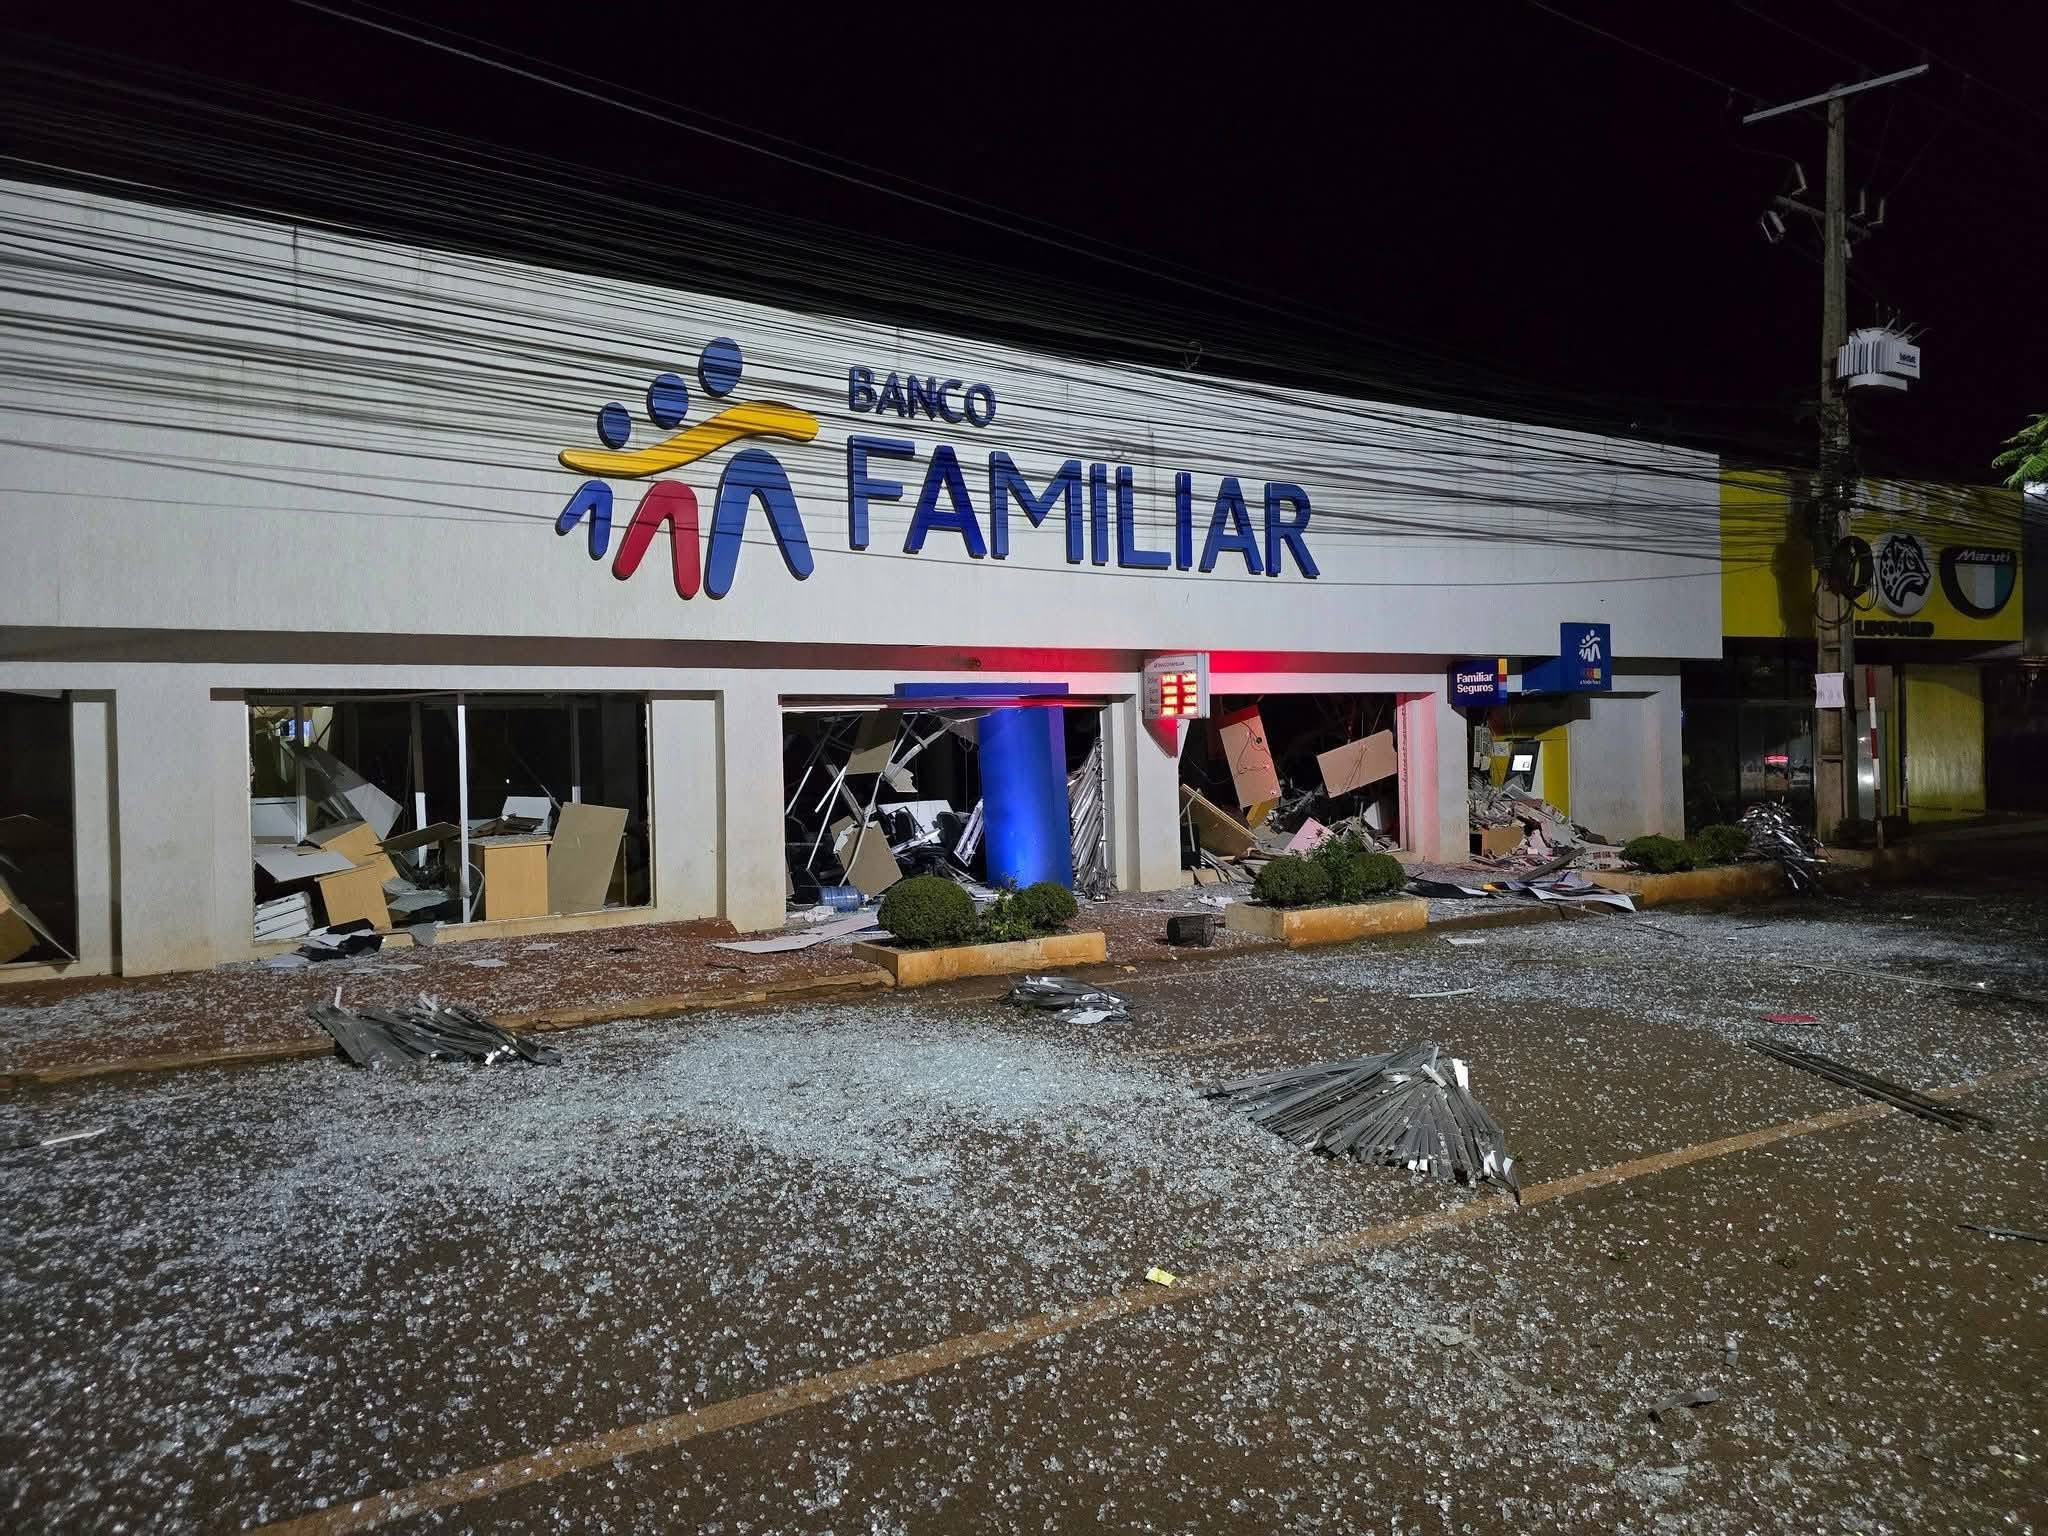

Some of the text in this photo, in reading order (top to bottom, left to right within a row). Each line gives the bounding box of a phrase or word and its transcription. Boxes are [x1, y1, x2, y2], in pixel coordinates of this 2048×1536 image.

[849, 366, 996, 427] BANCO
[848, 435, 1319, 579] FAMILIAR
[1956, 549, 2010, 563] Maruti
[1456, 672, 1493, 683] Familiar
[1456, 684, 1493, 694] Seguros
